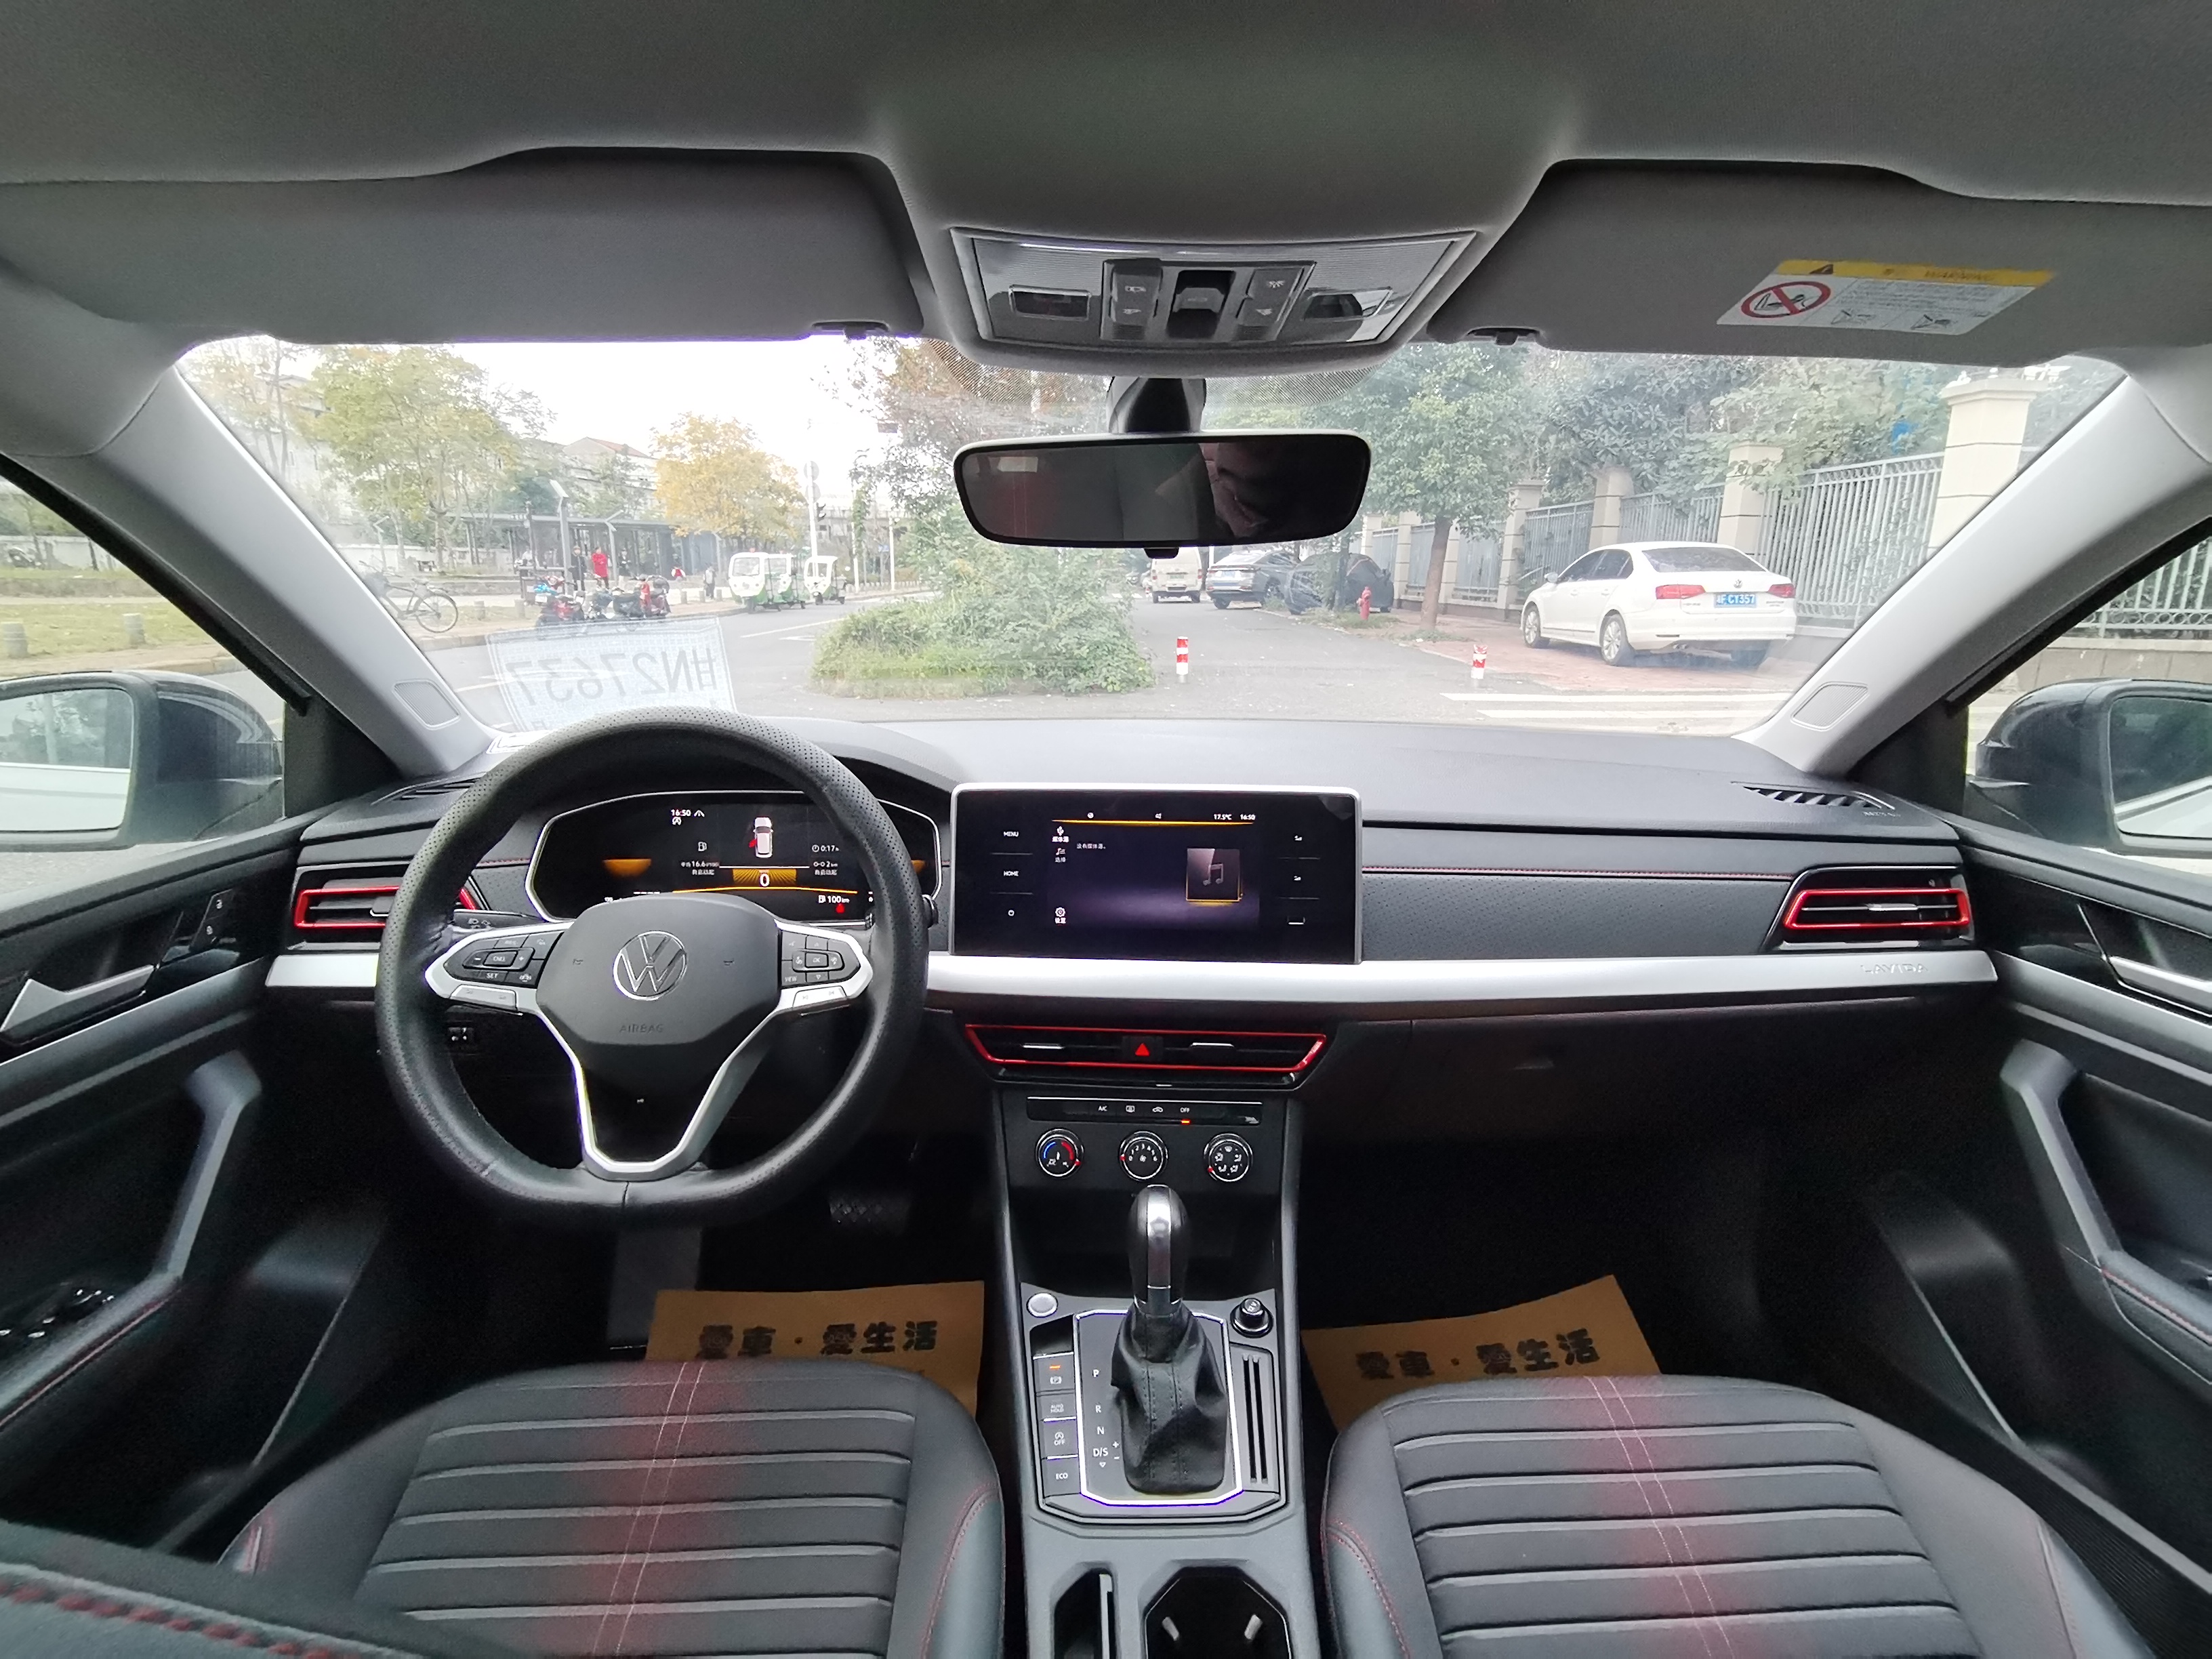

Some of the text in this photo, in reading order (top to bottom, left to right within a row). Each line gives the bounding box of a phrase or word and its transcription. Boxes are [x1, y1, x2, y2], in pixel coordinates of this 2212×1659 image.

[760, 873, 770, 887] 0
[1860, 962, 1929, 975] LAVIDA
[619, 1023, 664, 1033] AIRBAG
[1092, 1369, 1099, 1378] P
[1095, 1404, 1102, 1413] R
[1097, 1426, 1105, 1435] N
[1092, 1447, 1109, 1457] D/S
